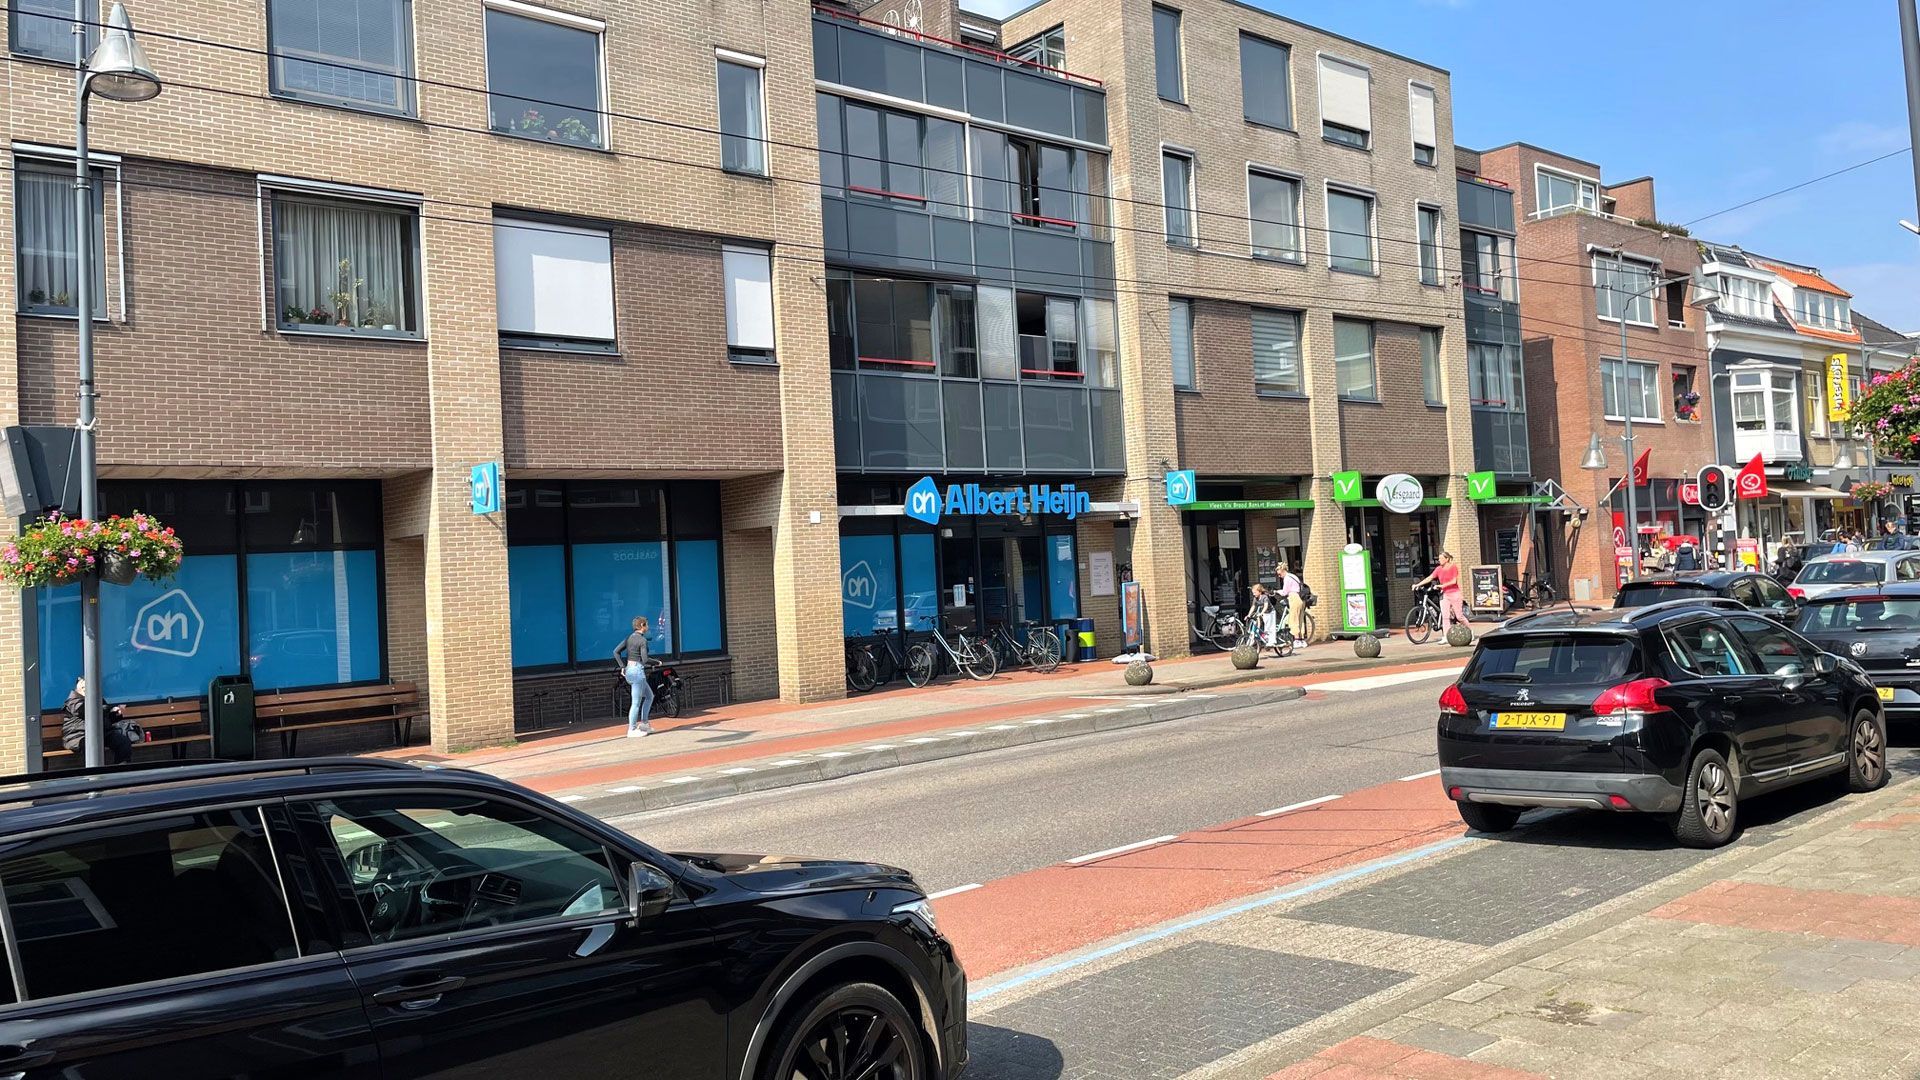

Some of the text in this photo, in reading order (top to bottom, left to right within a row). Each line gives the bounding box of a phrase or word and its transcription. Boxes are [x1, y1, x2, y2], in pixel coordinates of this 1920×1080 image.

[945, 483, 1090, 520] Albert Heijn
[1503, 714, 1557, 725] 2-TJX-91
